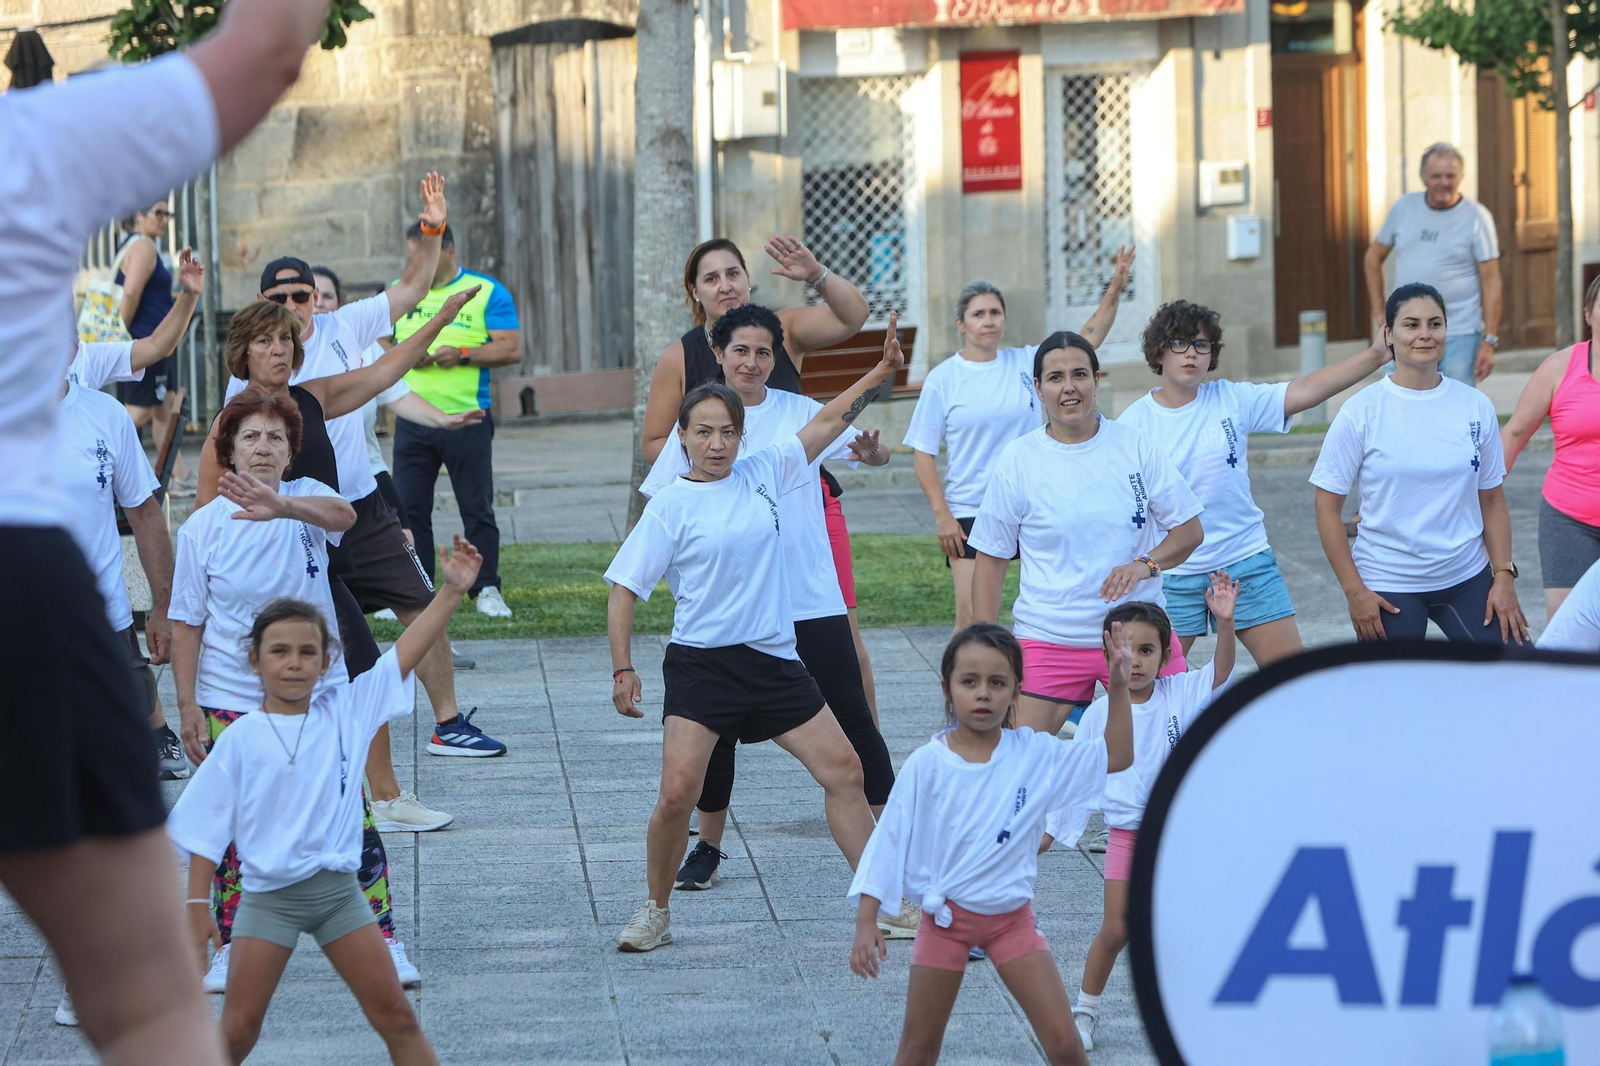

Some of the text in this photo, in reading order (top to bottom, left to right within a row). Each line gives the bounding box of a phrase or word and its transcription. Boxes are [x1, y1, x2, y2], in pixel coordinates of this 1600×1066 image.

[1221, 418, 1236, 455] DEPORTE
[1129, 473, 1145, 514] DEPORTE
[1136, 472, 1148, 501] Atlántico
